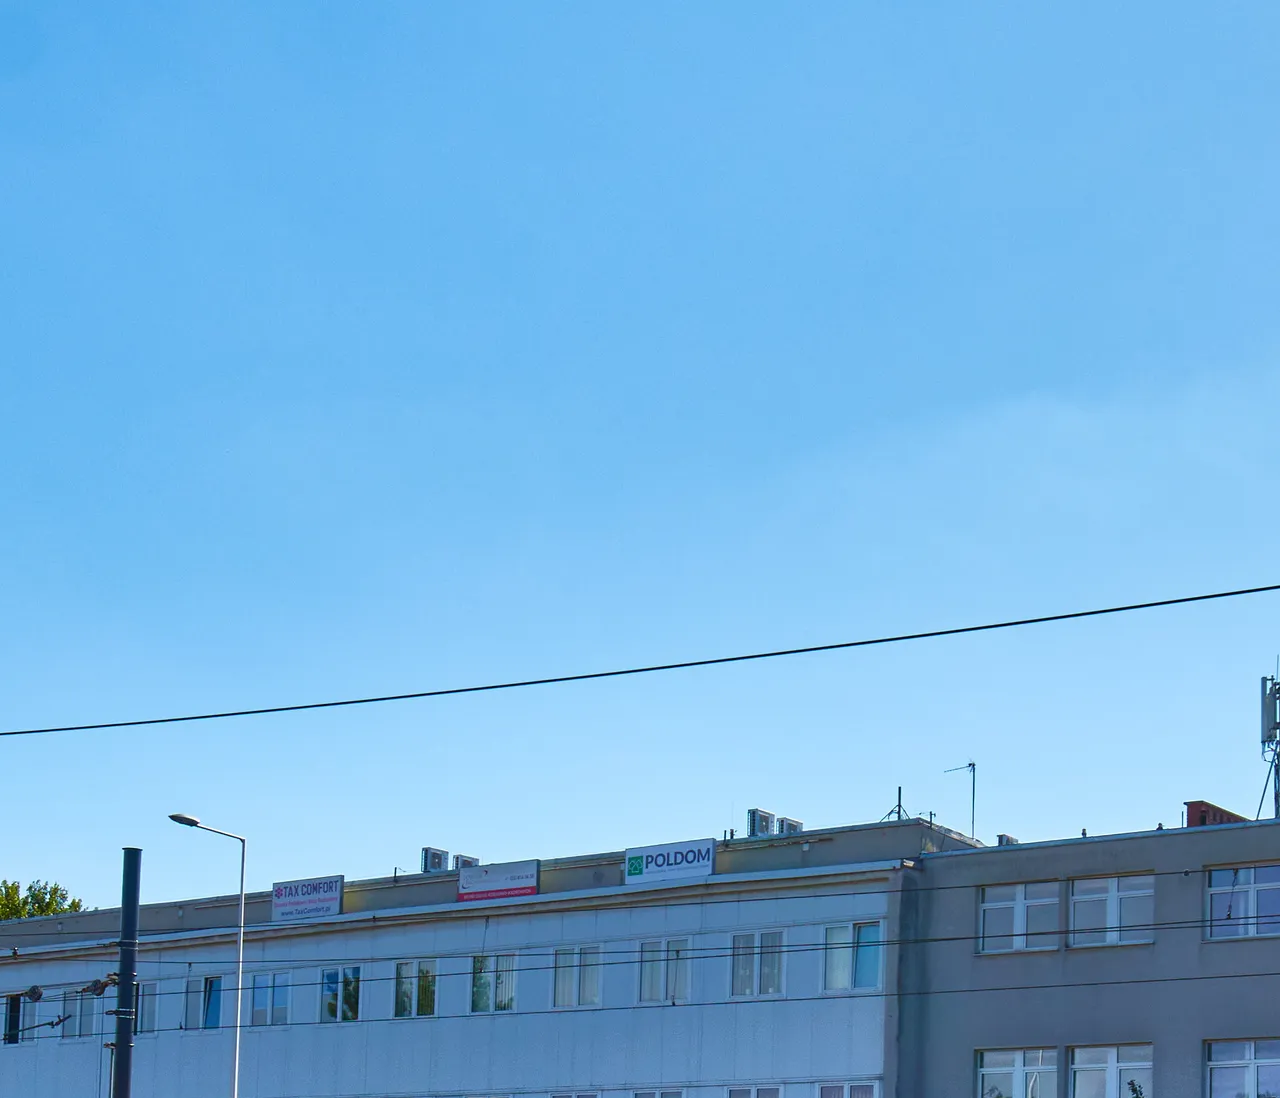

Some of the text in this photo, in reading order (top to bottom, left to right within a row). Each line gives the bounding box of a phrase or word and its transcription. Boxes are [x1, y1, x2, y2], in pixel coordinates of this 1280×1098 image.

[645, 847, 711, 869] POLDOM
[283, 880, 339, 898] TAX COMFORT
